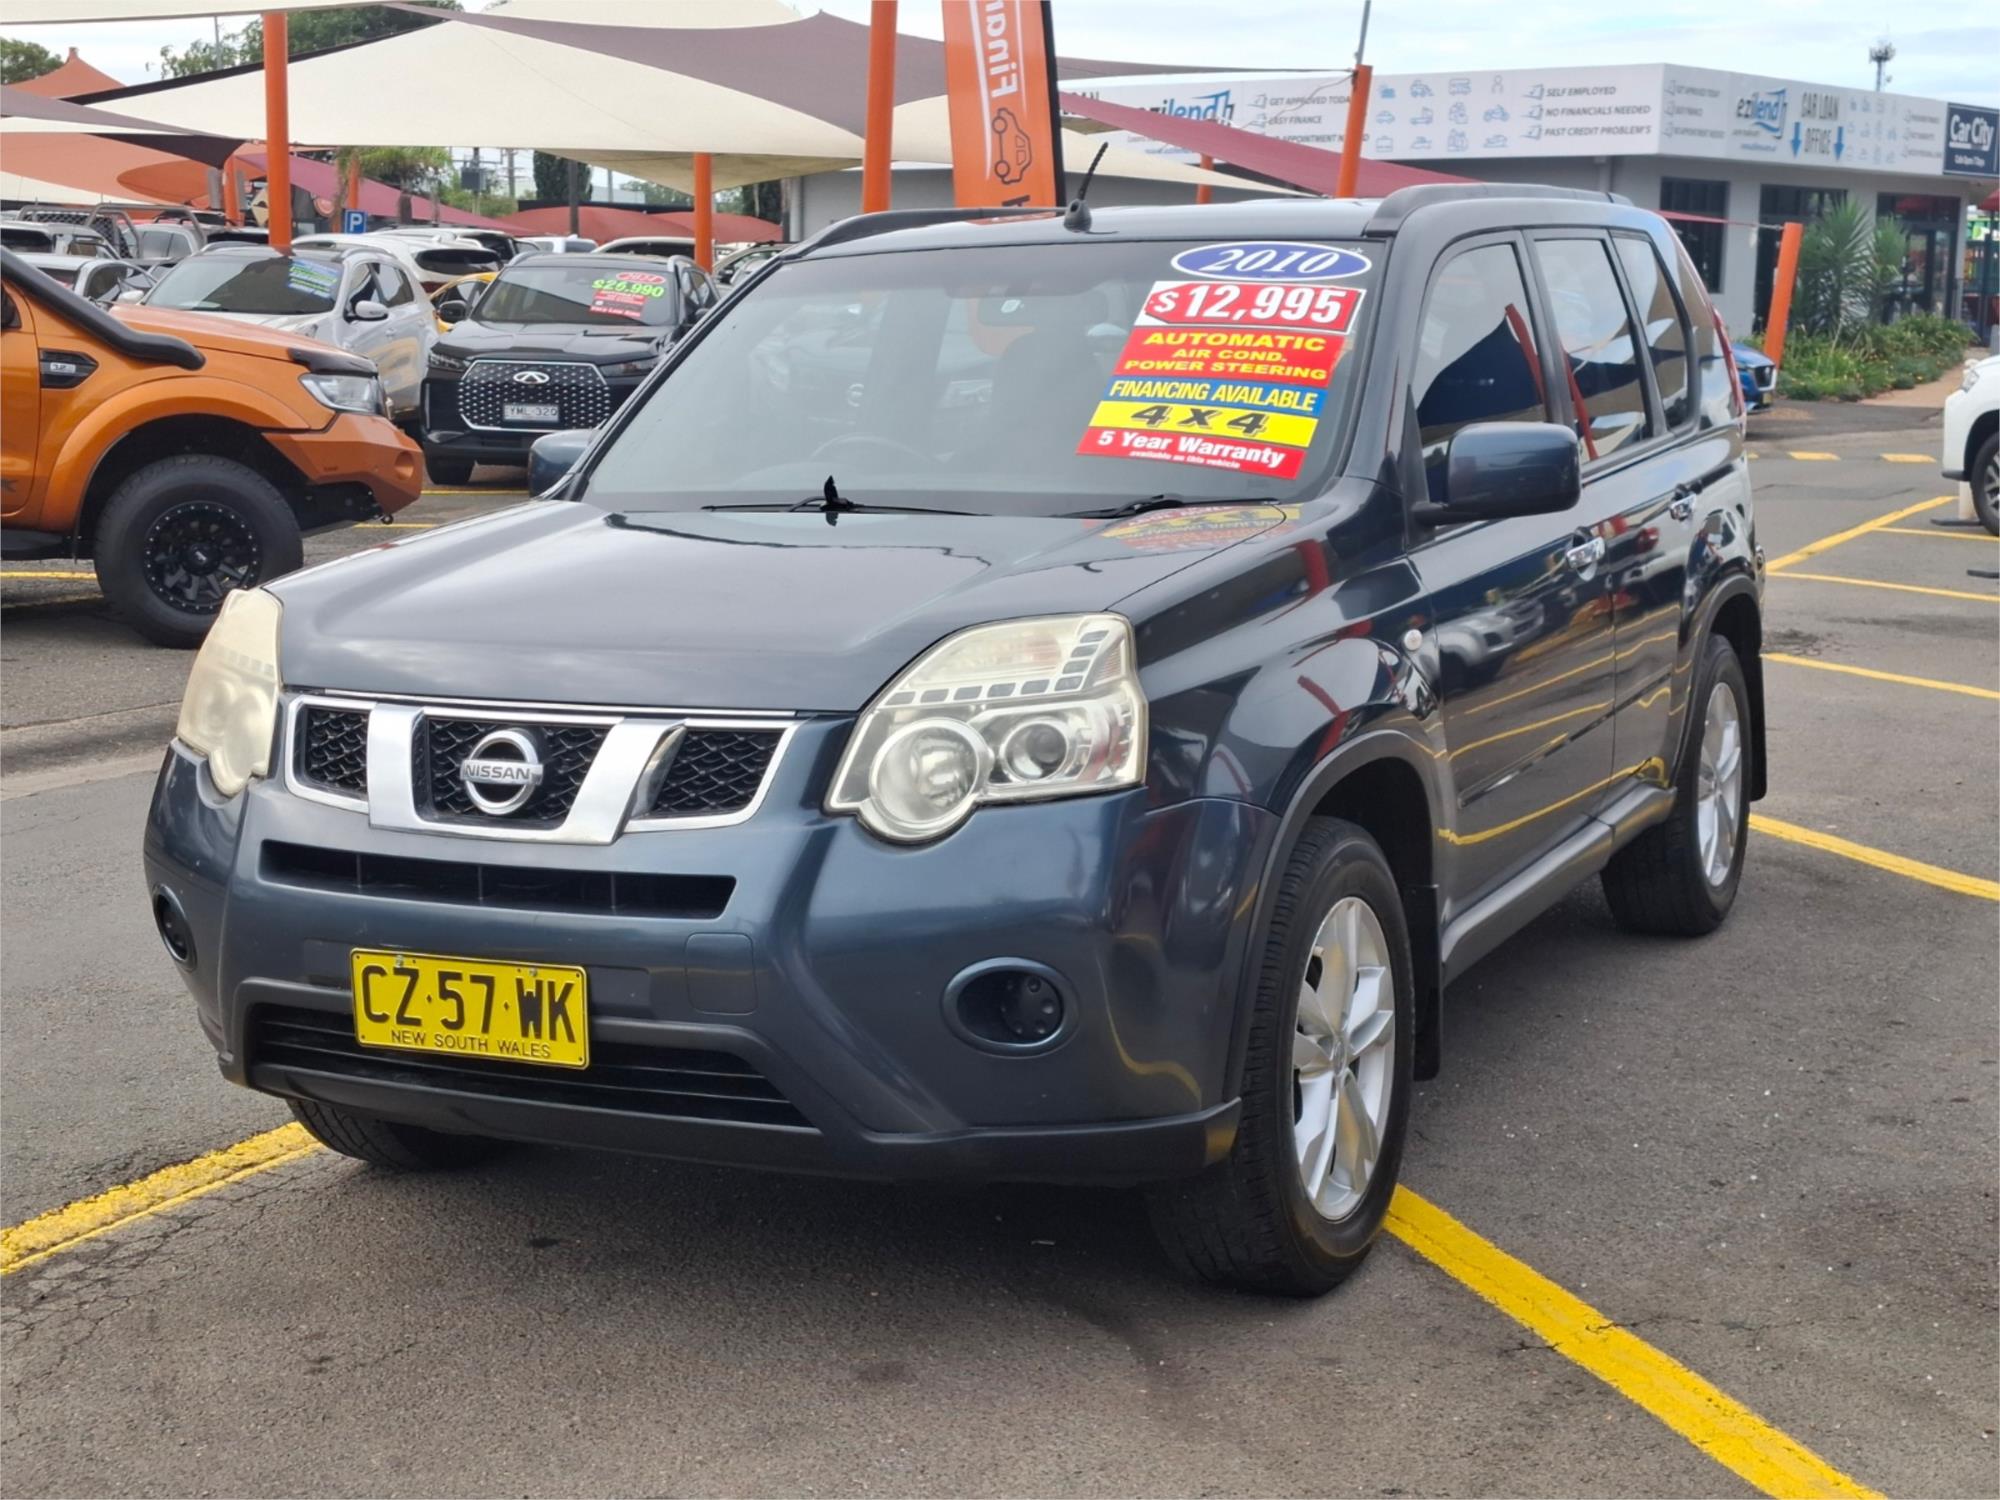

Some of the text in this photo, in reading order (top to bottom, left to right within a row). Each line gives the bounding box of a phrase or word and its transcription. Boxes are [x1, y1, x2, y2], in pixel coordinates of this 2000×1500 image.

[1269, 97, 1285, 106] GET
[1328, 96, 1352, 104] TODA
[1546, 86, 1617, 97] SELF EMPLOYED
[1545, 105, 1651, 117] NO FINANCIALS NEEDED
[1567, 126, 1599, 137] CREDIT
[350, 213, 363, 232] P
[1198, 249, 1340, 273] 2010
[1143, 332, 1327, 352] AUTOMATIC
[1172, 348, 1287, 363] AIR COND.
[1124, 360, 1328, 380] POWER STEERING
[1109, 379, 1319, 412] FINANCING AVAILABLE
[1131, 405, 1172, 428] 4
[1226, 412, 1270, 437] 4
[1097, 430, 1286, 468] 5 Year Warranty
[464, 764, 531, 780] NISSAN
[392, 1030, 552, 1058] NEW SOUTH WALES
